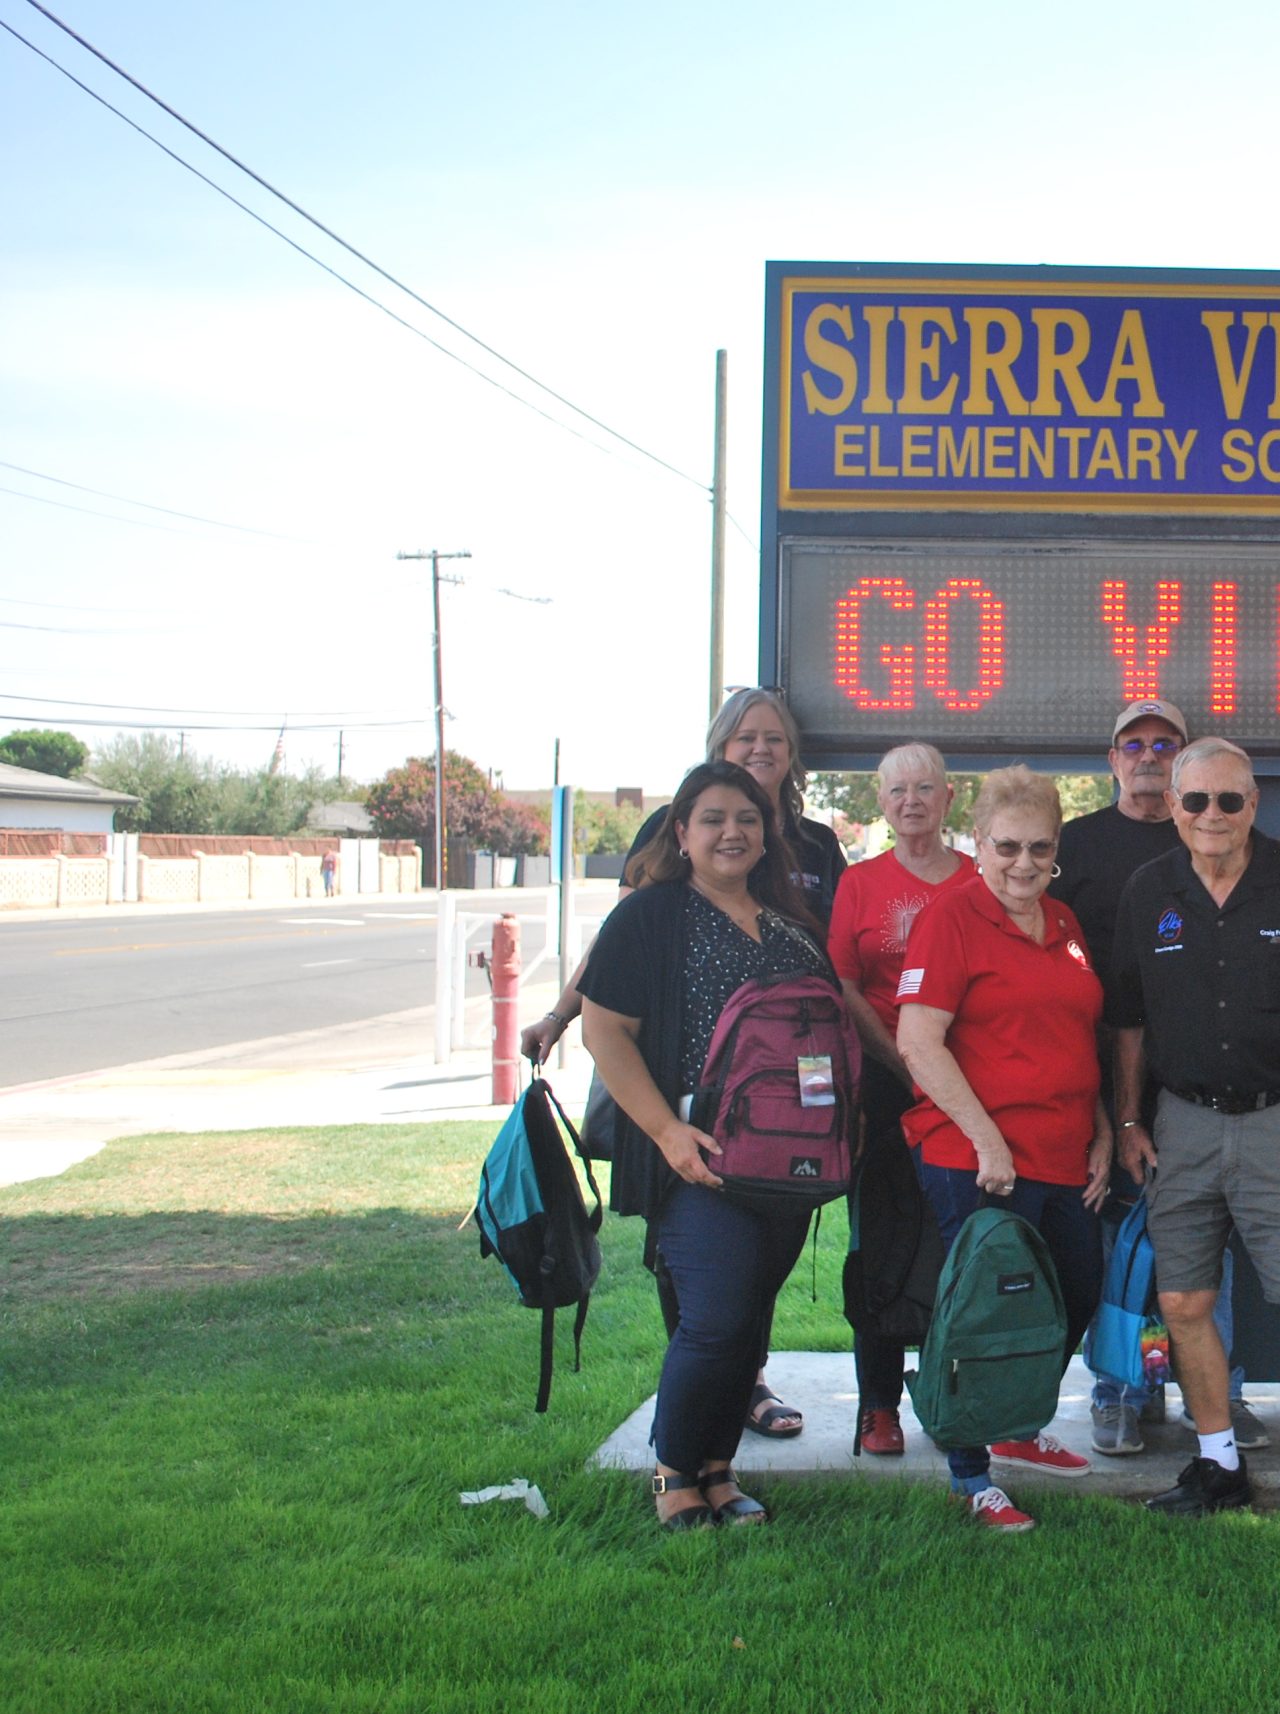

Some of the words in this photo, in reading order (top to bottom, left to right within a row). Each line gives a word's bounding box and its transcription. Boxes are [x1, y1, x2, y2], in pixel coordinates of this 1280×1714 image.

[802, 302, 1164, 420] SIERRA
[834, 424, 1198, 482] ELEMENTARY
[833, 576, 1004, 711] GO
[1260, 929, 1275, 937] Craig
